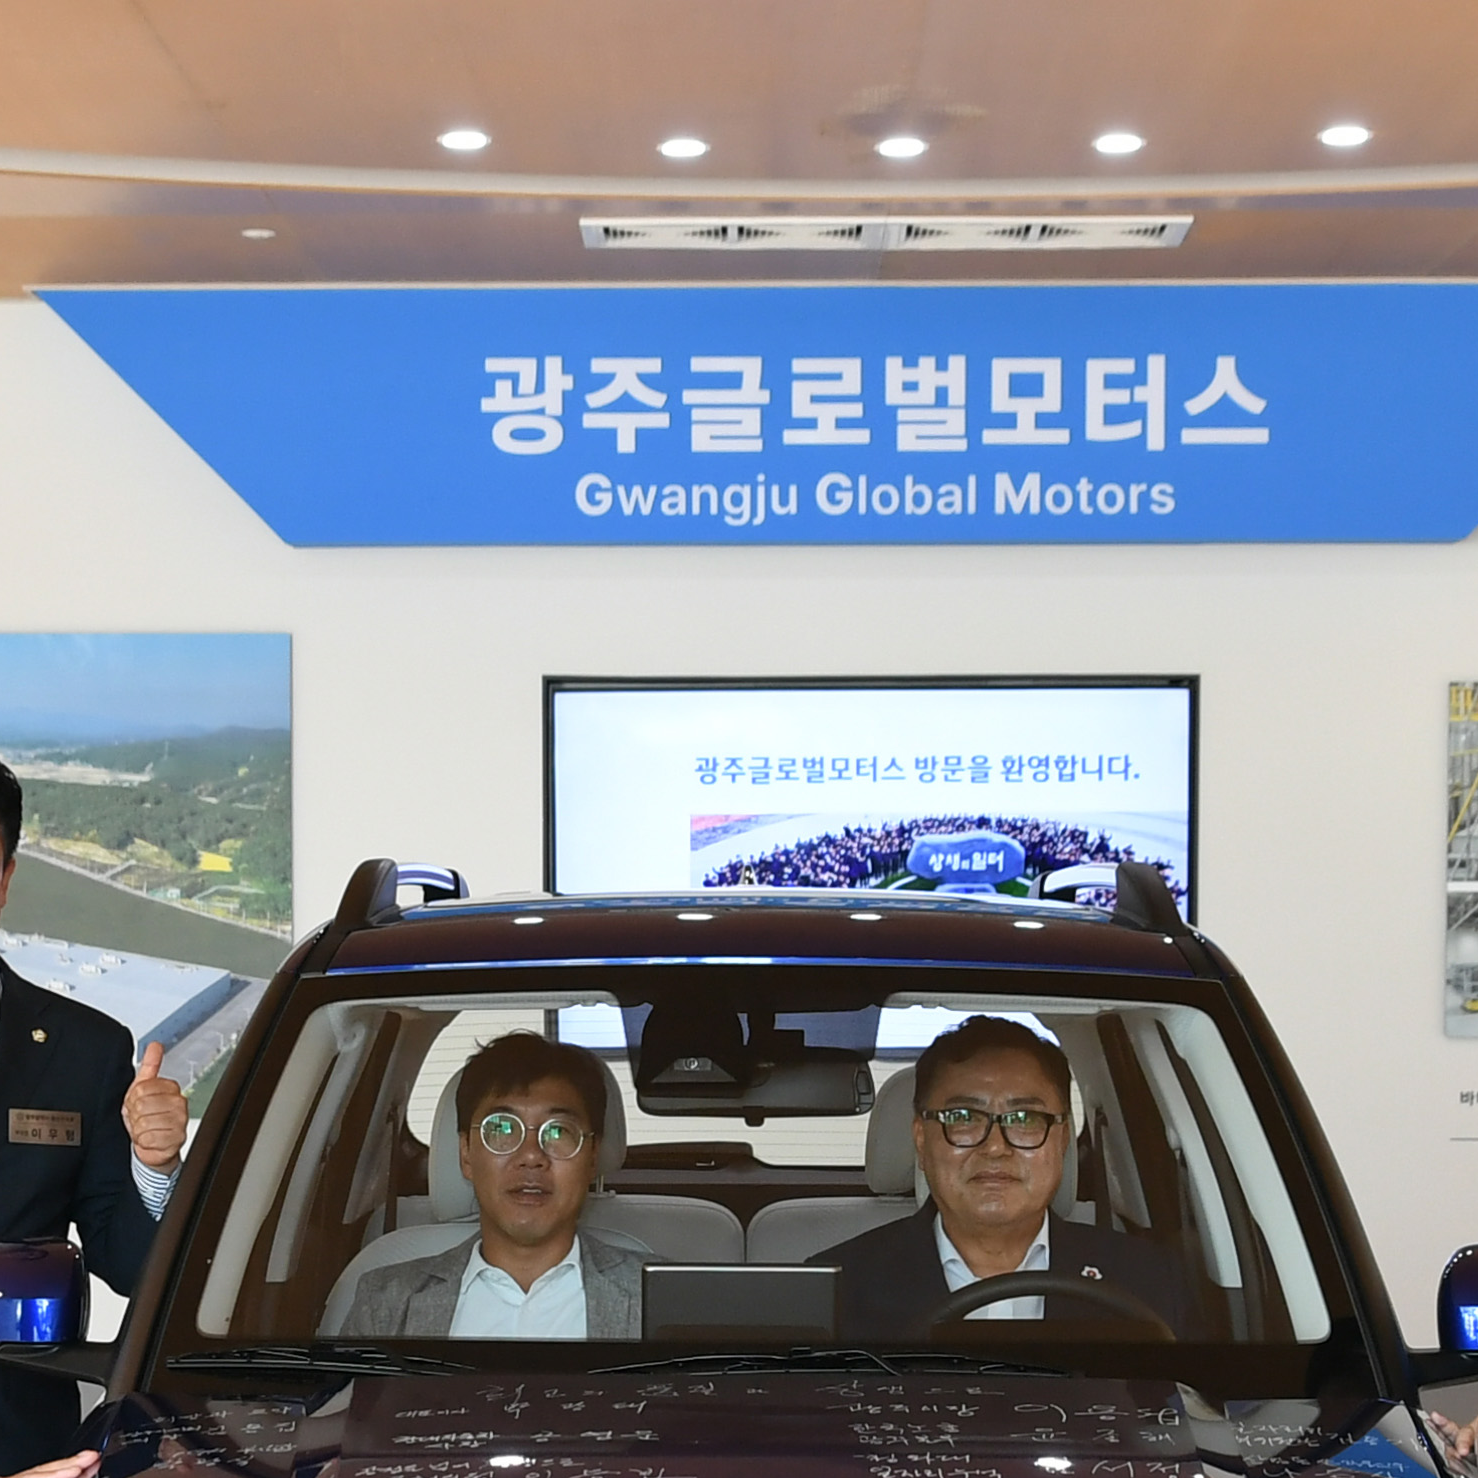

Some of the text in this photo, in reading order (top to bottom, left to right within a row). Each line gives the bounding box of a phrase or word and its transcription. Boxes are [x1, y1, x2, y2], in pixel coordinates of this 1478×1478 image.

[479, 352, 1270, 456] 광주글로벌모터스
[573, 471, 1176, 527] Gwangju Global Motors
[693, 753, 1141, 786] 광주글로벌모터스 방문을 환영합니다.
